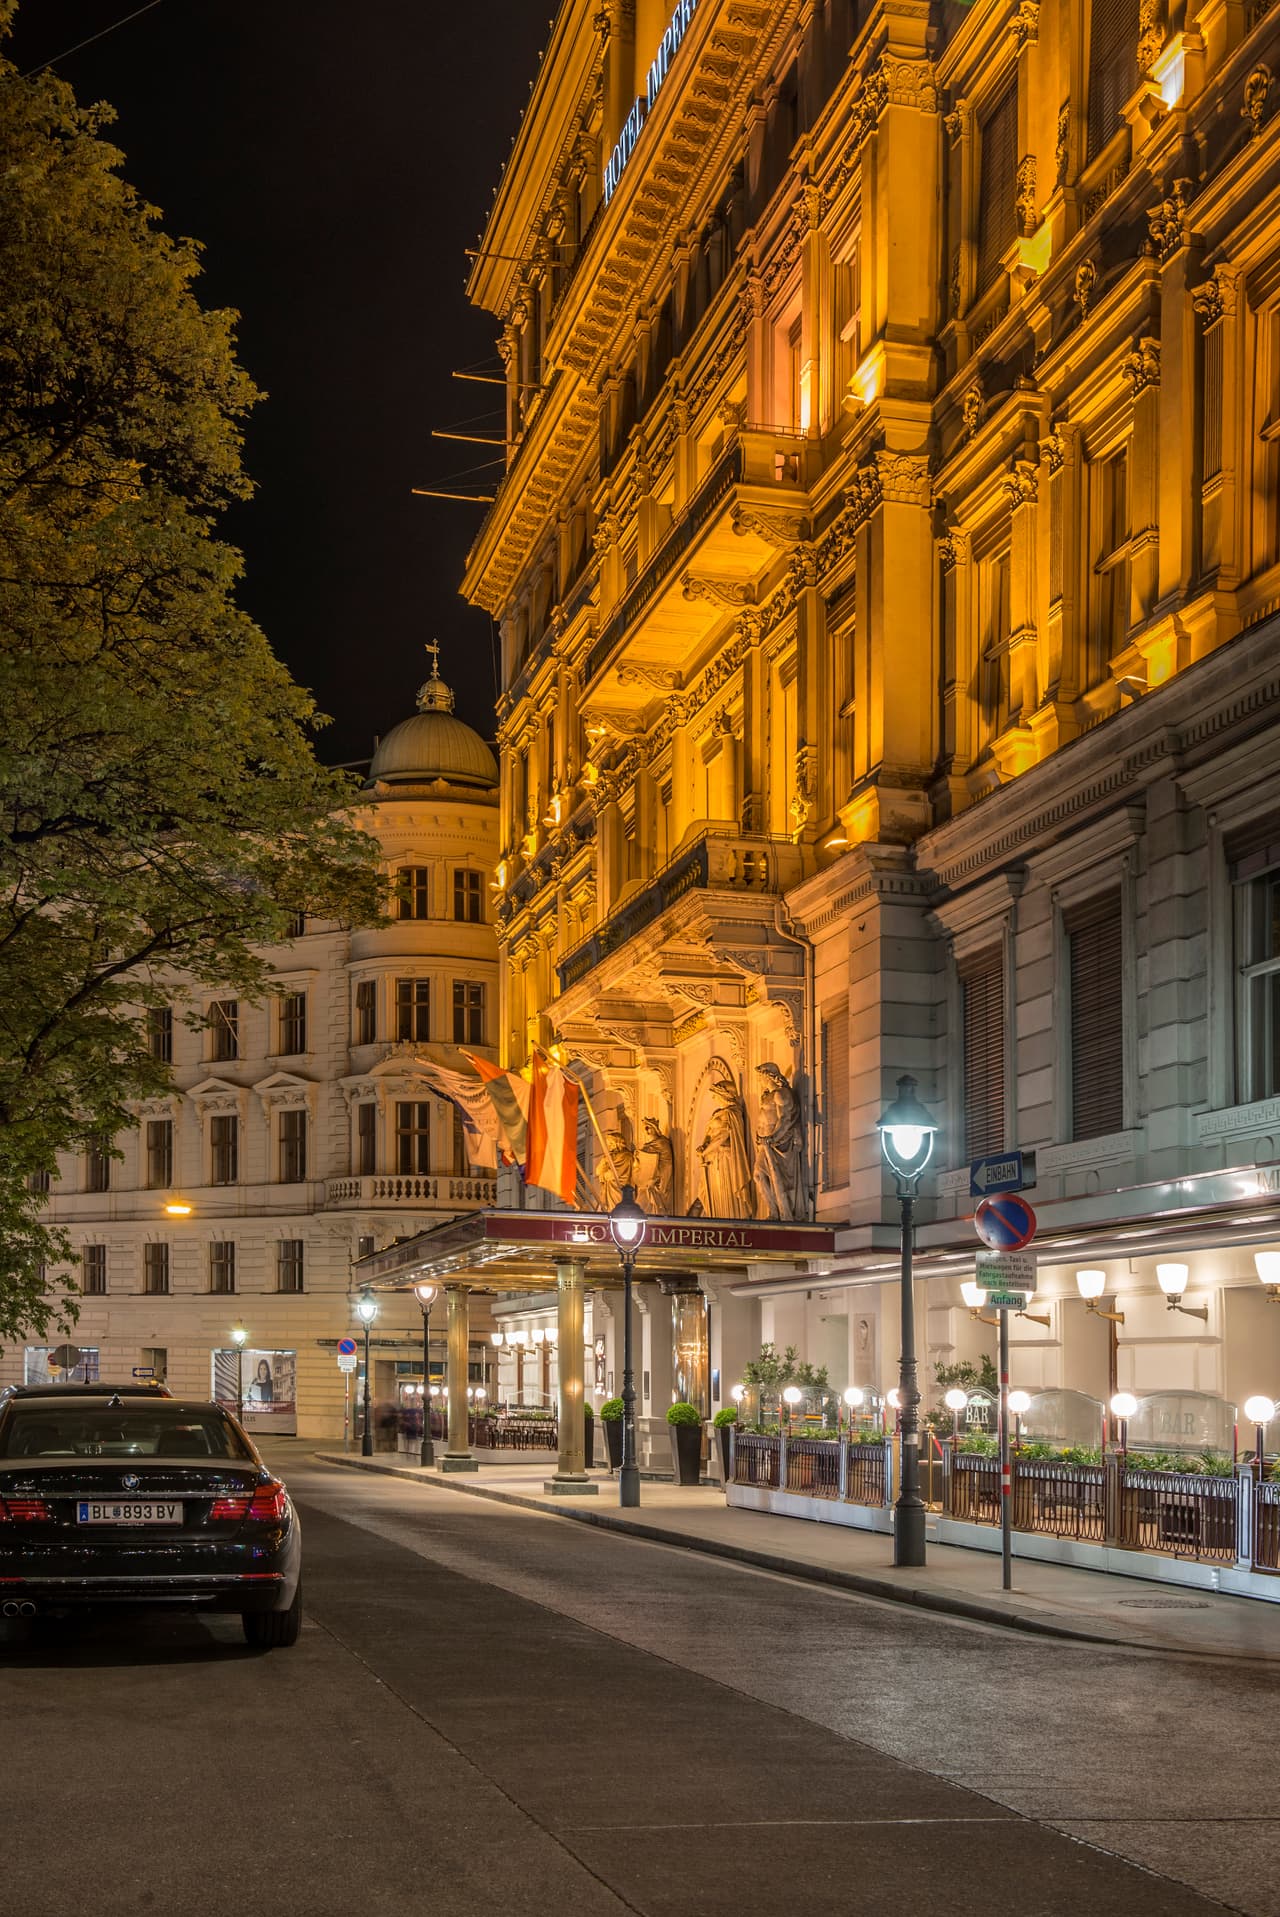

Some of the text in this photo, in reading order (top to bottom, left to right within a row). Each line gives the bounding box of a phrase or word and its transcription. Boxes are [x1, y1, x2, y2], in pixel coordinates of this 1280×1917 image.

[604, 0, 696, 208] HOTEL IMPER
[986, 1162, 1017, 1183] EINBAHN
[650, 1227, 753, 1247] IMPERIAL
[979, 1263, 1012, 1271] Mietwagen
[1023, 1264, 1033, 1272] die
[990, 1294, 1023, 1307] Anfang
[965, 1406, 989, 1424] BAR
[1159, 1411, 1196, 1435] BAR
[92, 1505, 176, 1519] BL 893 BV
